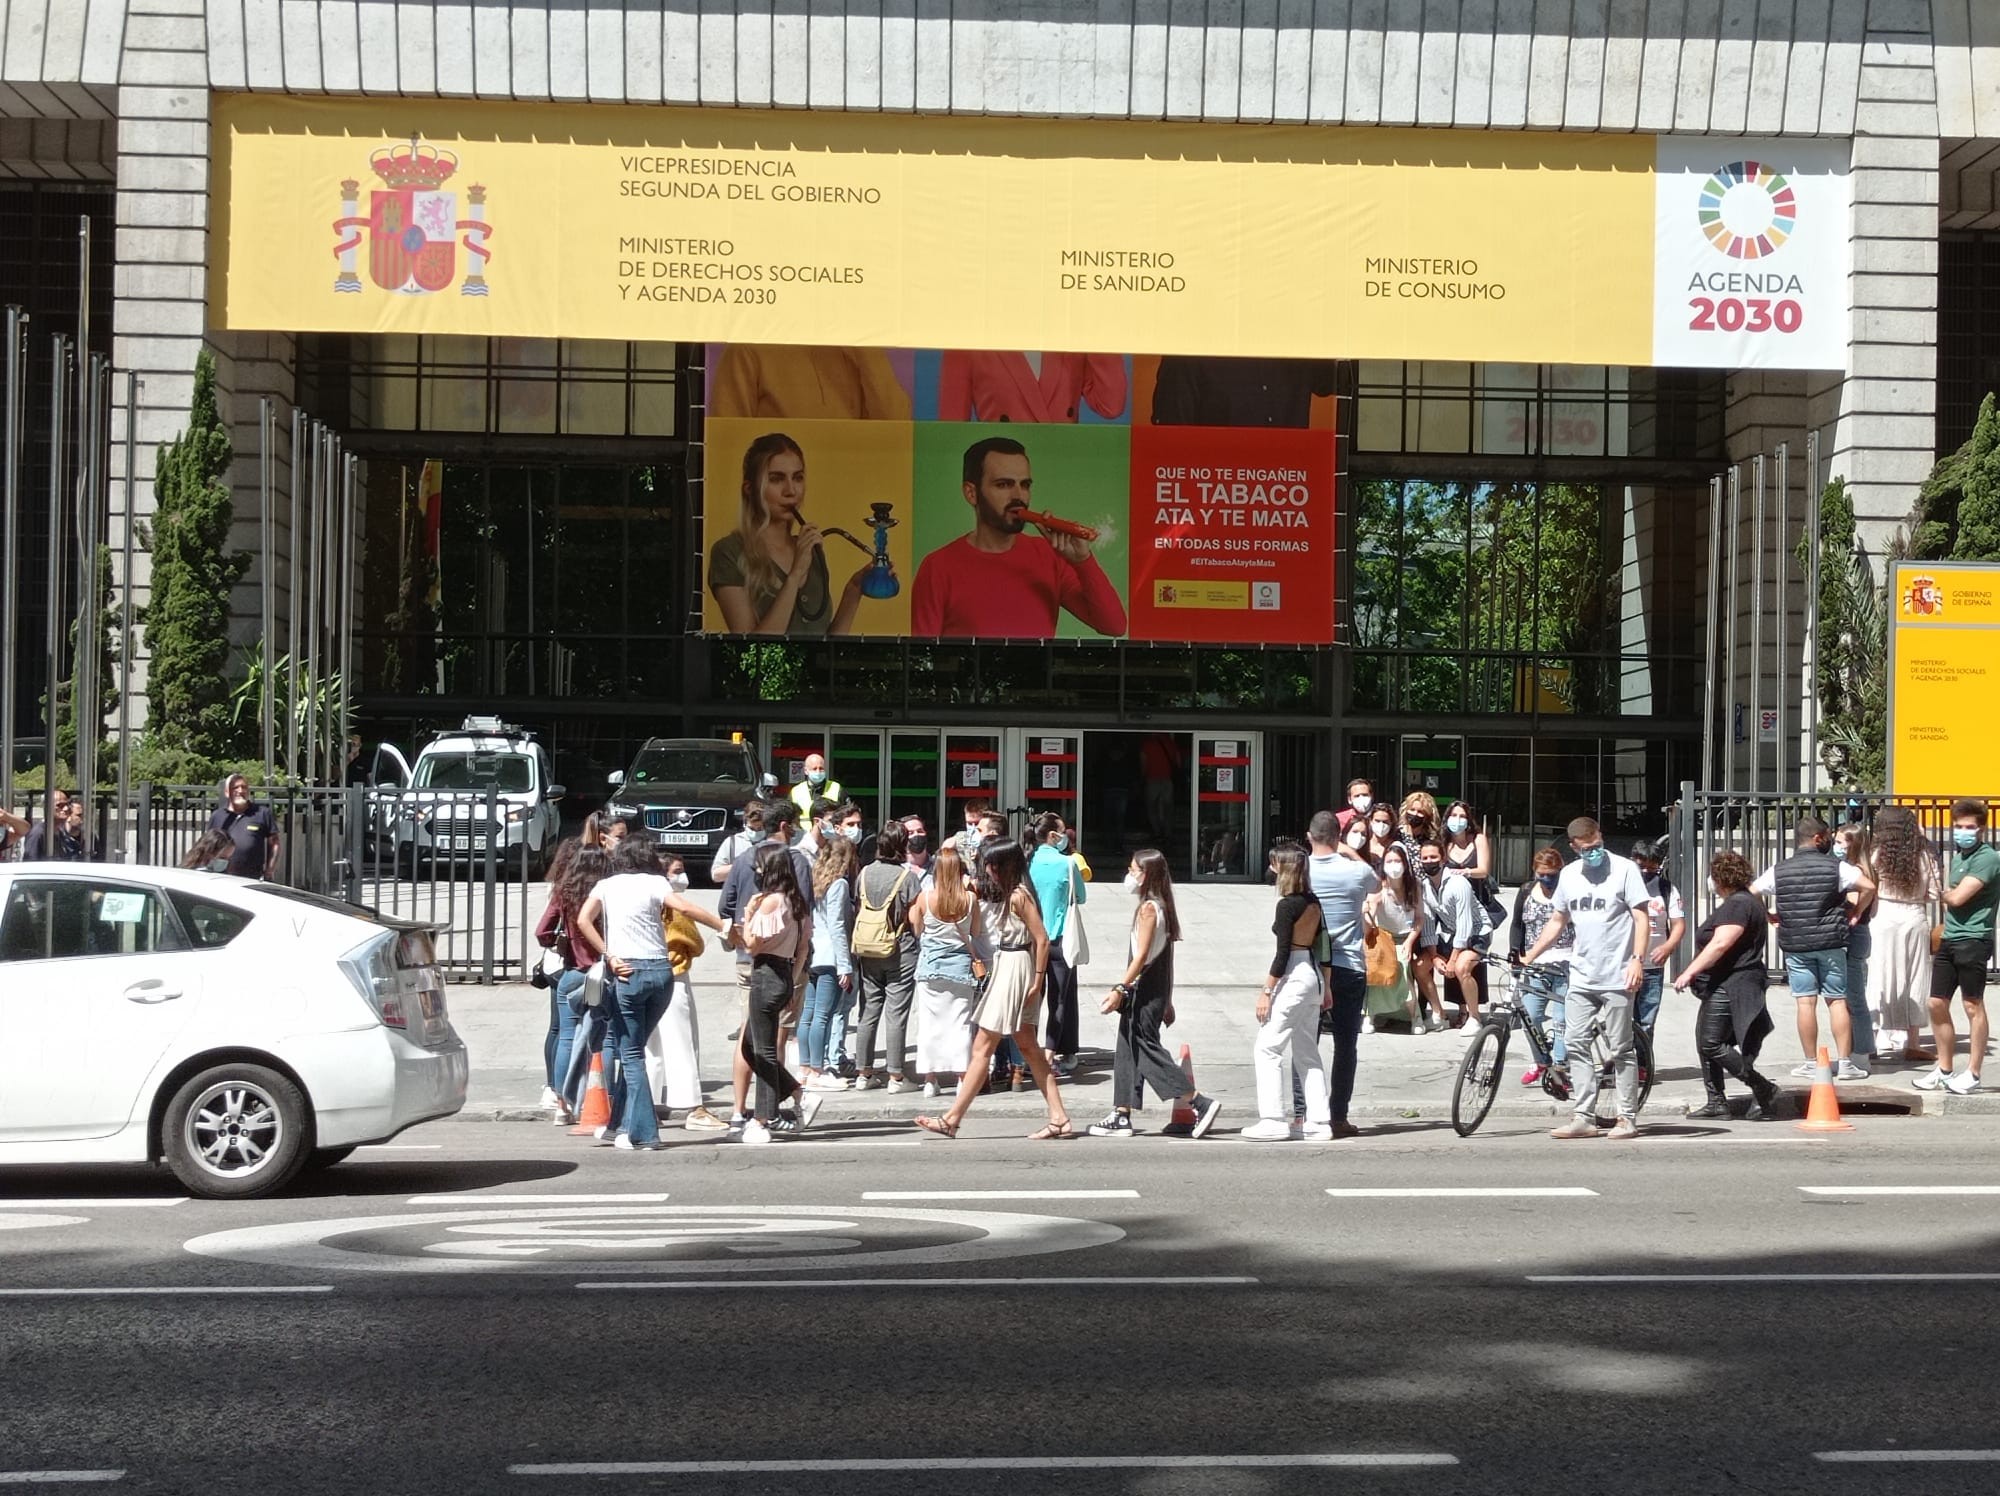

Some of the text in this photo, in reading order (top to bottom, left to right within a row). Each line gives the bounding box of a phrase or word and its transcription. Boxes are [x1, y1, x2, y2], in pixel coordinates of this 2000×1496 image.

[621, 156, 796, 178] VICEPRESIDENCIA
[620, 181, 881, 204] SEGUNDA DEL GOBIERNO
[619, 237, 734, 257] MINISTERIO
[1061, 250, 1175, 269] MINISTERIO
[1366, 257, 1478, 276] MINISTERIO
[619, 261, 864, 284] DE DERECHOS SOCIALES
[1061, 274, 1186, 293] DE SANIDAD
[1365, 281, 1506, 300] DE CONSUMO
[1687, 272, 1804, 294] AGENDA
[619, 285, 777, 305] Y AGENDA 2030
[1688, 297, 1803, 333] 2030
[1155, 467, 1307, 482] QUE NO TE ENGAÑEN
[1156, 482, 1309, 507] EL TABACO
[1155, 508, 1309, 528] ATA Y TE MATA
[1155, 538, 1309, 552] EN TODAS SUS FORMAS
[1951, 598, 1992, 606] DE ESPAÑA
[1952, 590, 1993, 598] GOBIERNO
